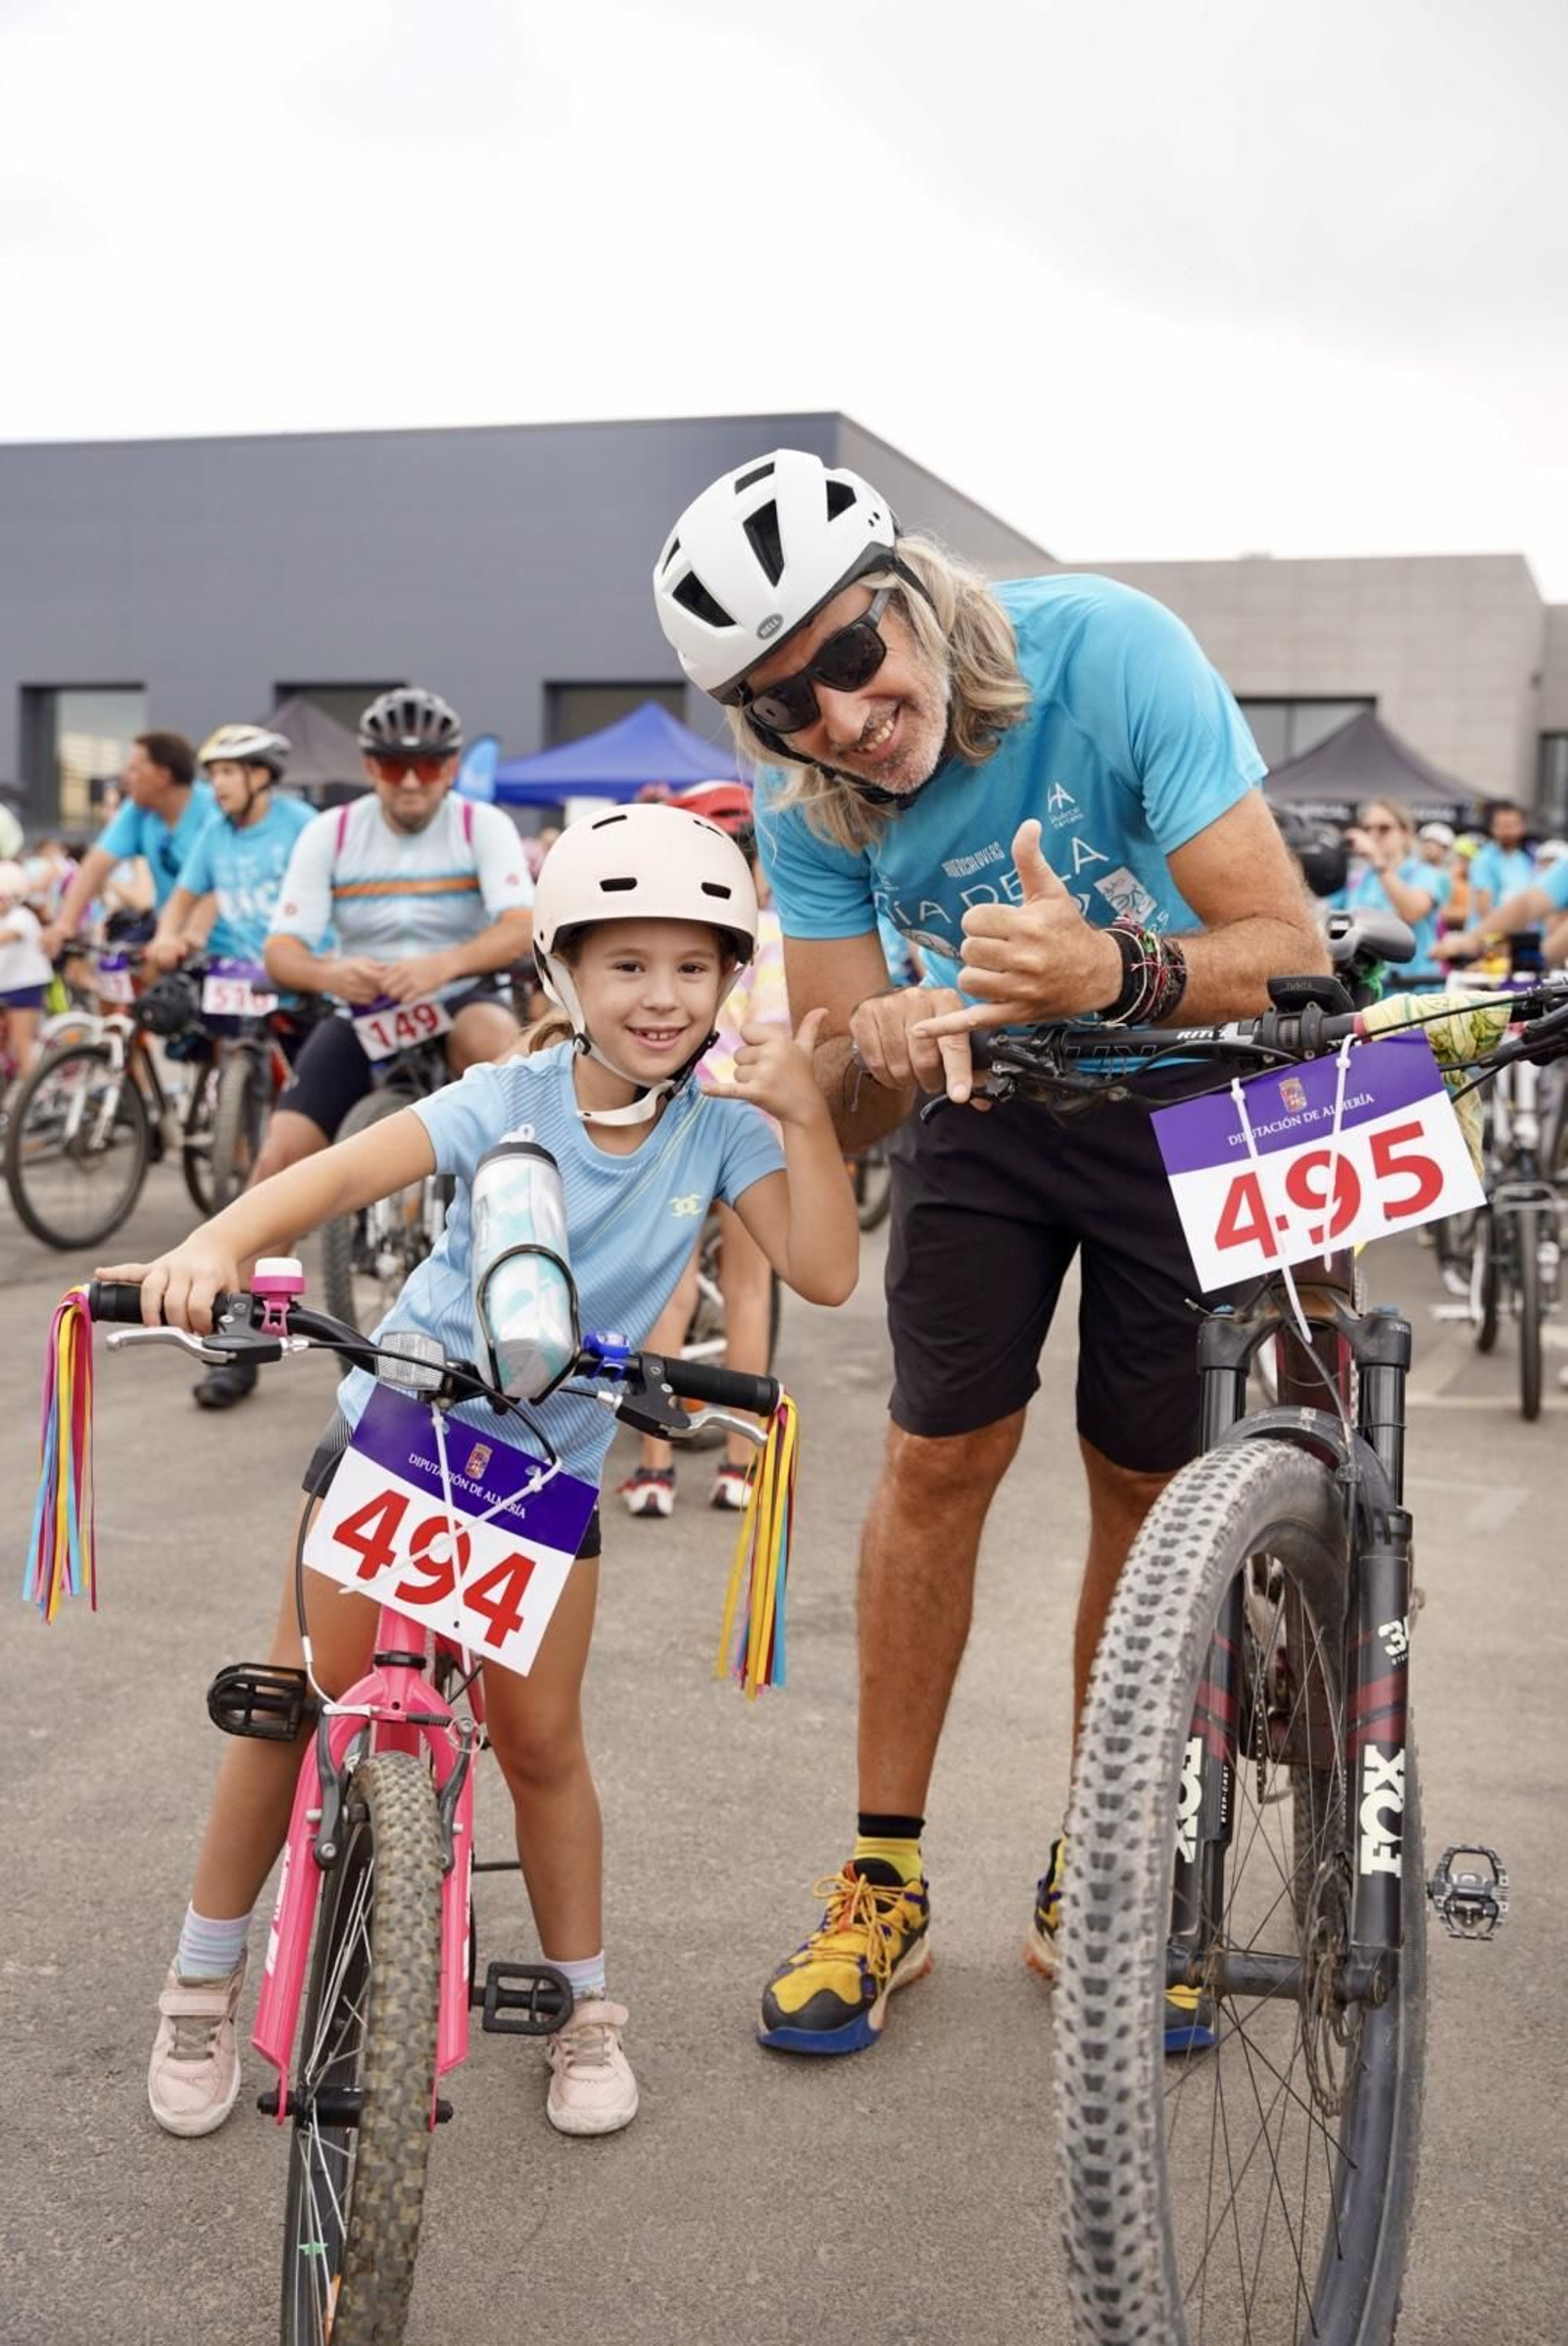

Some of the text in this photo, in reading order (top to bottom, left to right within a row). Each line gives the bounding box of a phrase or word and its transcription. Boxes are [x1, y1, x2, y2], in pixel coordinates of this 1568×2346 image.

[760, 617, 780, 637] BELL
[369, 1002, 439, 1048] 149
[1227, 1091, 1376, 1148] DIPUTACIÓN DE ALMERÍA
[1214, 1120, 1445, 1260] 495
[408, 1452, 526, 1521] DIPUTACIÓN DE ALMERÍA
[332, 1489, 536, 1649] 494
[1359, 1743, 1406, 1879] FOX
